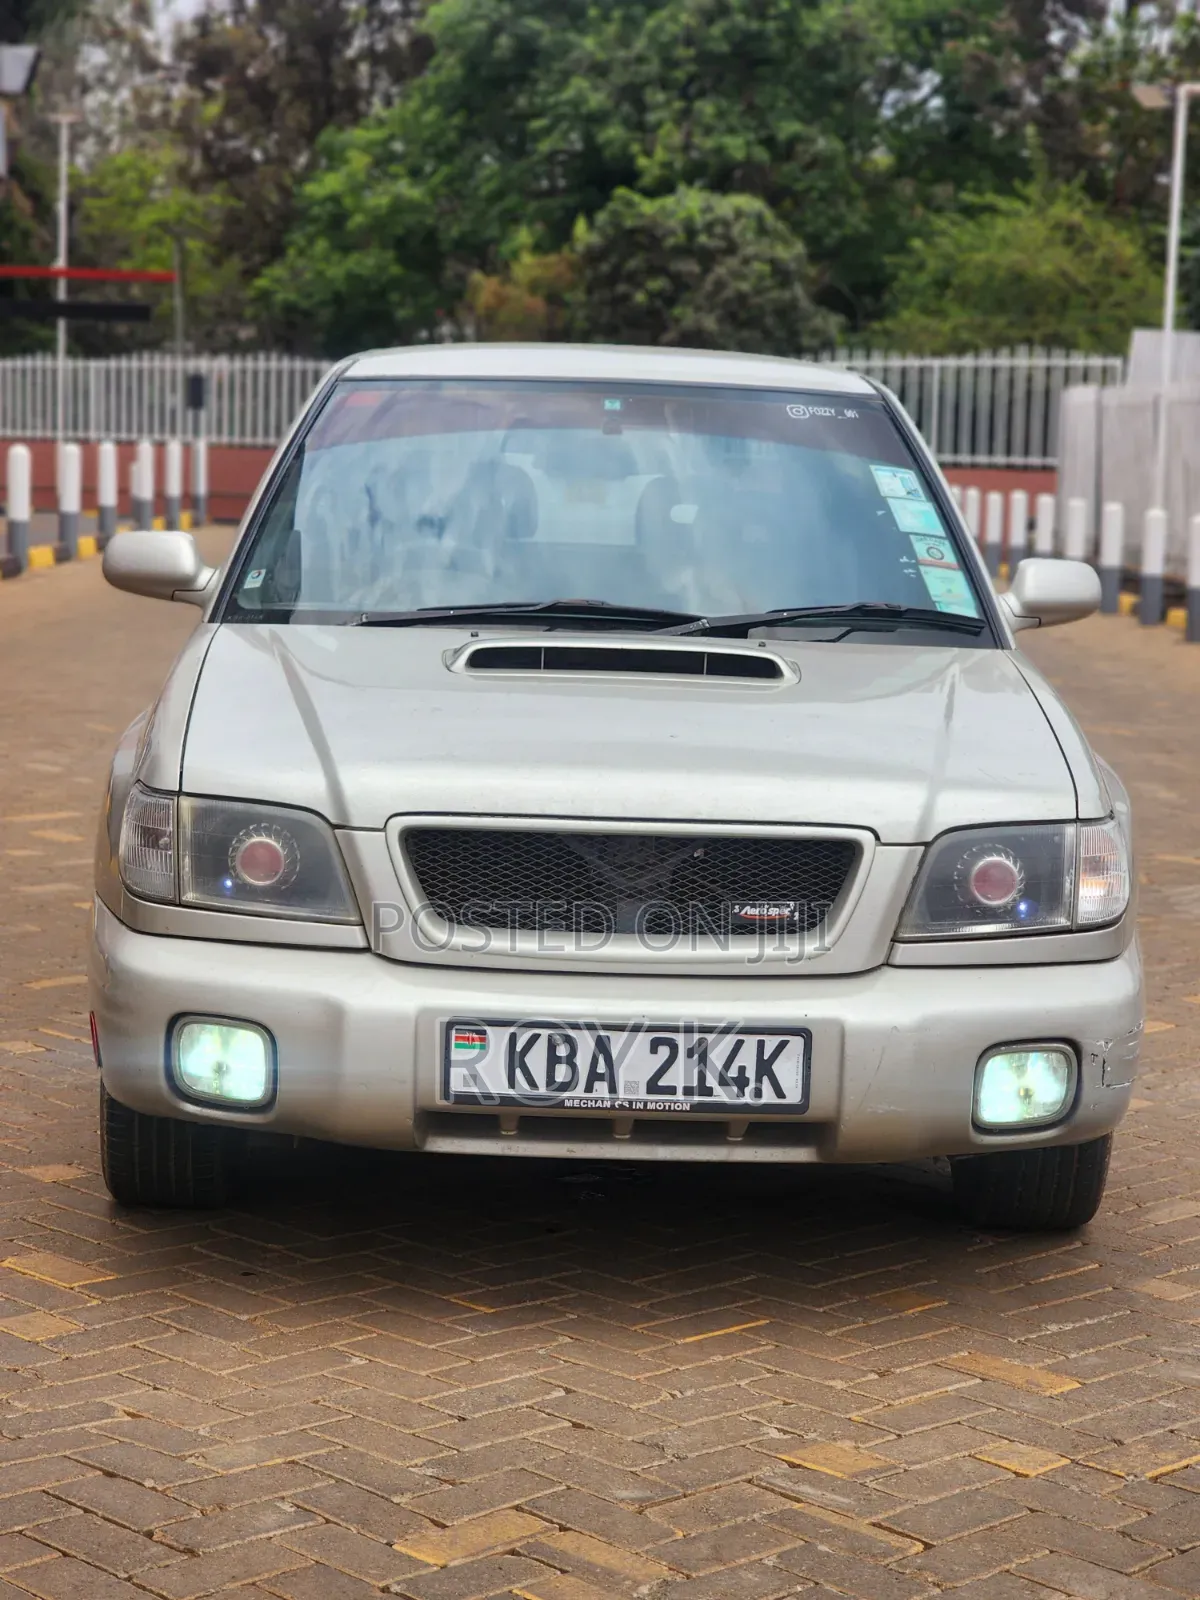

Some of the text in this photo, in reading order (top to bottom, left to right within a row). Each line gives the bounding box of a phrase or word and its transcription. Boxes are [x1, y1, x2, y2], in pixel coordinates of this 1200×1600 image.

[508, 1031, 617, 1094] KBA
[646, 1036, 791, 1100] 214K
[564, 1099, 691, 1111] MECHANCS IN MOTION
